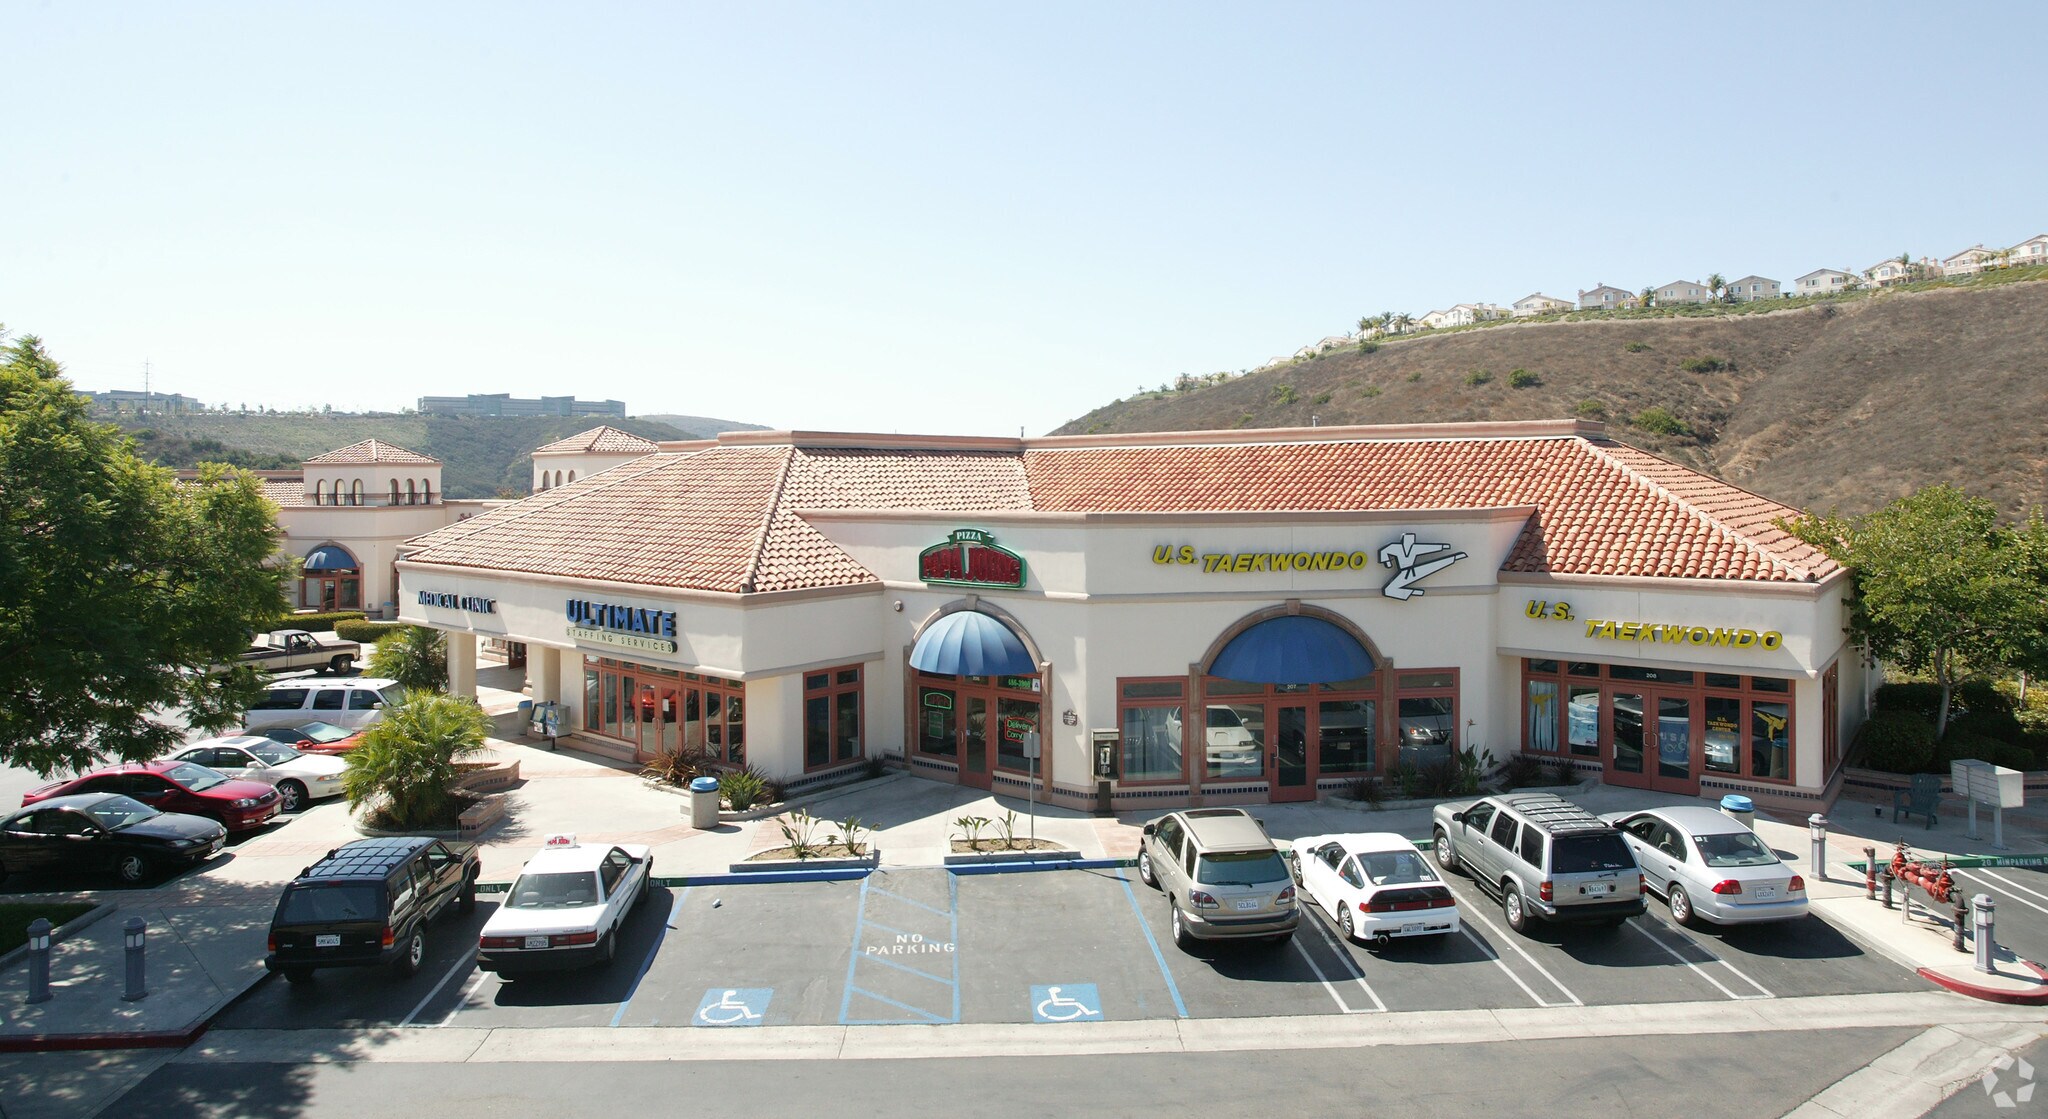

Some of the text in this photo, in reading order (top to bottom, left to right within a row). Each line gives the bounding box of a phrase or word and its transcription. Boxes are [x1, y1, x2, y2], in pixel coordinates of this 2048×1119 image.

[956, 531, 982, 540] PIZZA
[1152, 545, 1368, 574] U.S. TAEKWONDO
[418, 590, 497, 615] MEDICAL CLINIC
[566, 598, 677, 638] ULTIMATE
[1525, 599, 1784, 652] U.S. TAEKWONDO
[566, 628, 673, 653] STAFFING SERVICES
[480, 884, 502, 893] ONLY
[650, 879, 671, 888] ONLY
[896, 933, 923, 944] NO
[865, 942, 955, 956] PARKING
